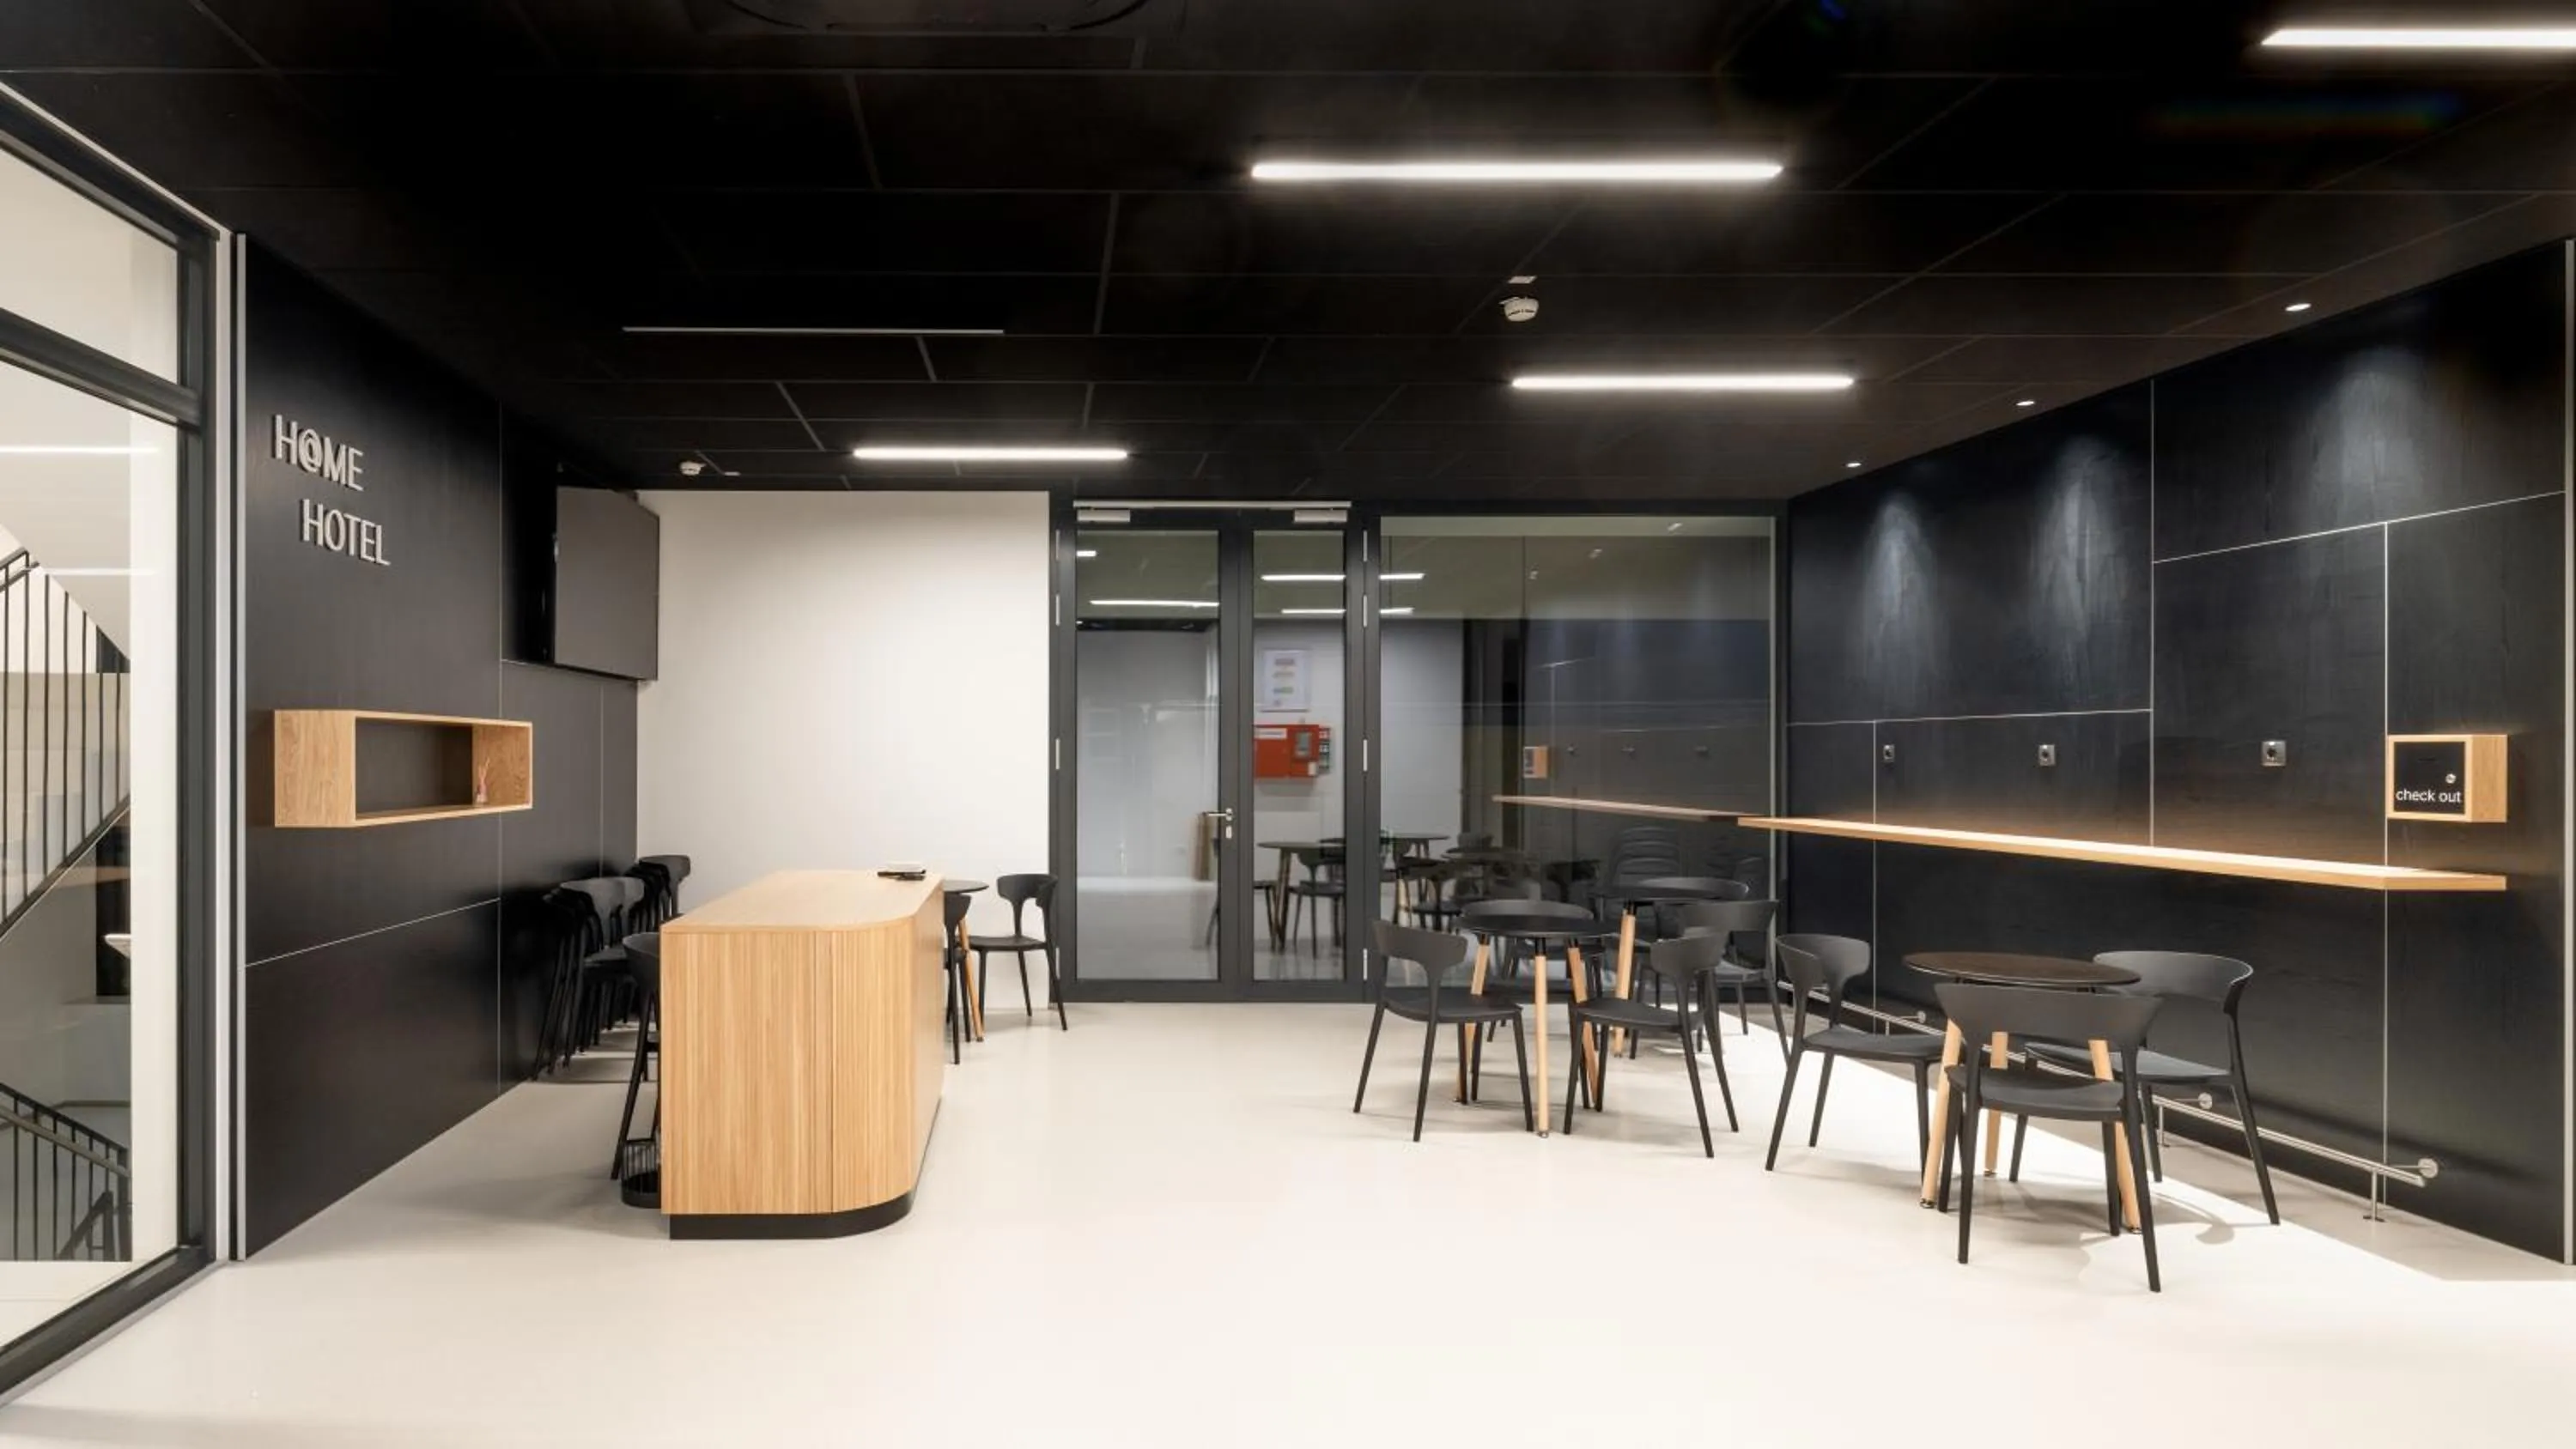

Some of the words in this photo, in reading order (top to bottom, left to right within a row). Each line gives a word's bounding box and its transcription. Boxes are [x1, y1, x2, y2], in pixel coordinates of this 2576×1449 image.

[274, 414, 364, 491] H@ME
[301, 498, 391, 566] HOTEL
[2396, 789, 2435, 802] check
[2439, 791, 2462, 803] out
